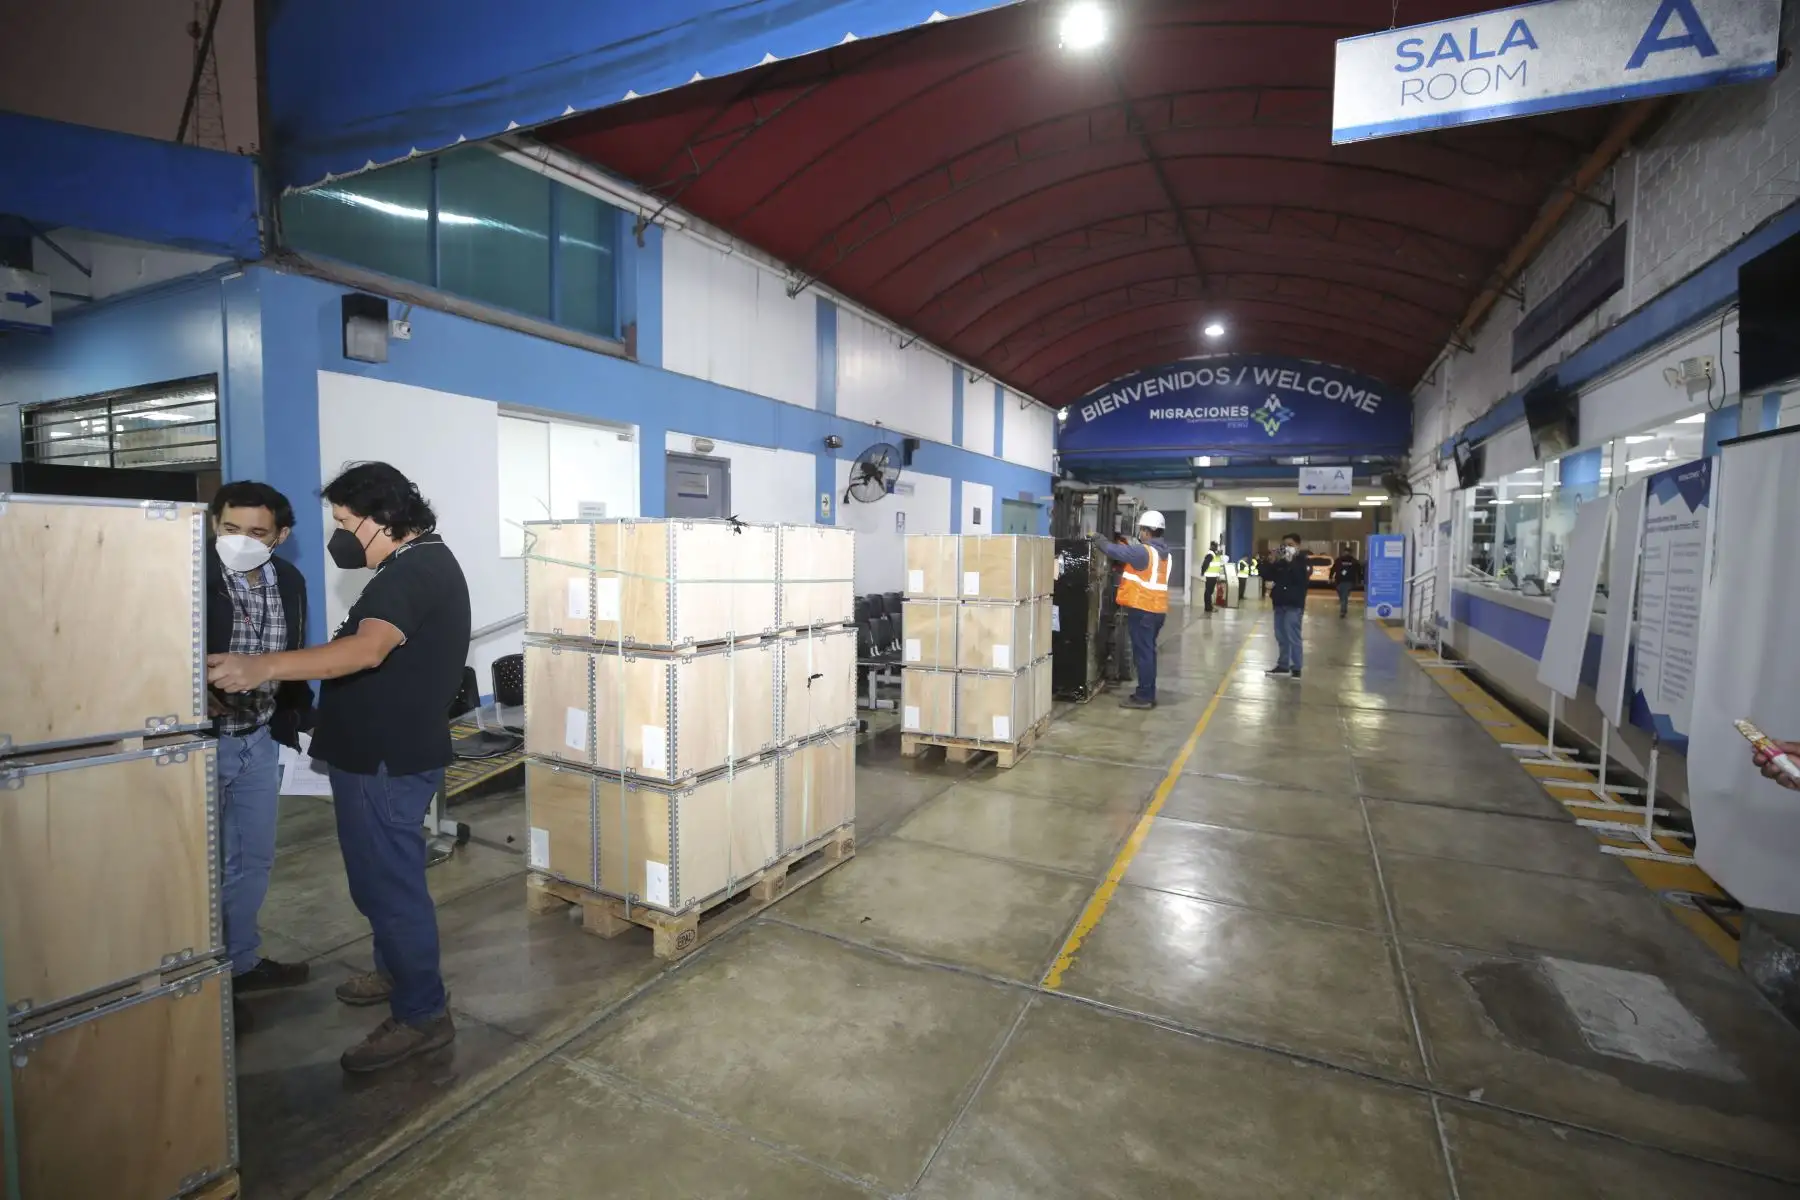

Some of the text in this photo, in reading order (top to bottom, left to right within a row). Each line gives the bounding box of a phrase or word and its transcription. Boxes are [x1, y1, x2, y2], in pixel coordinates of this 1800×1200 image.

[1394, 0, 1719, 73] SALA A
[1400, 60, 1528, 106] ROOM
[1081, 366, 1231, 423] BIENVENIDOS
[1253, 366, 1382, 414] WELCOME
[1149, 406, 1249, 420] MIGRACIONES
[1334, 469, 1345, 480] A
